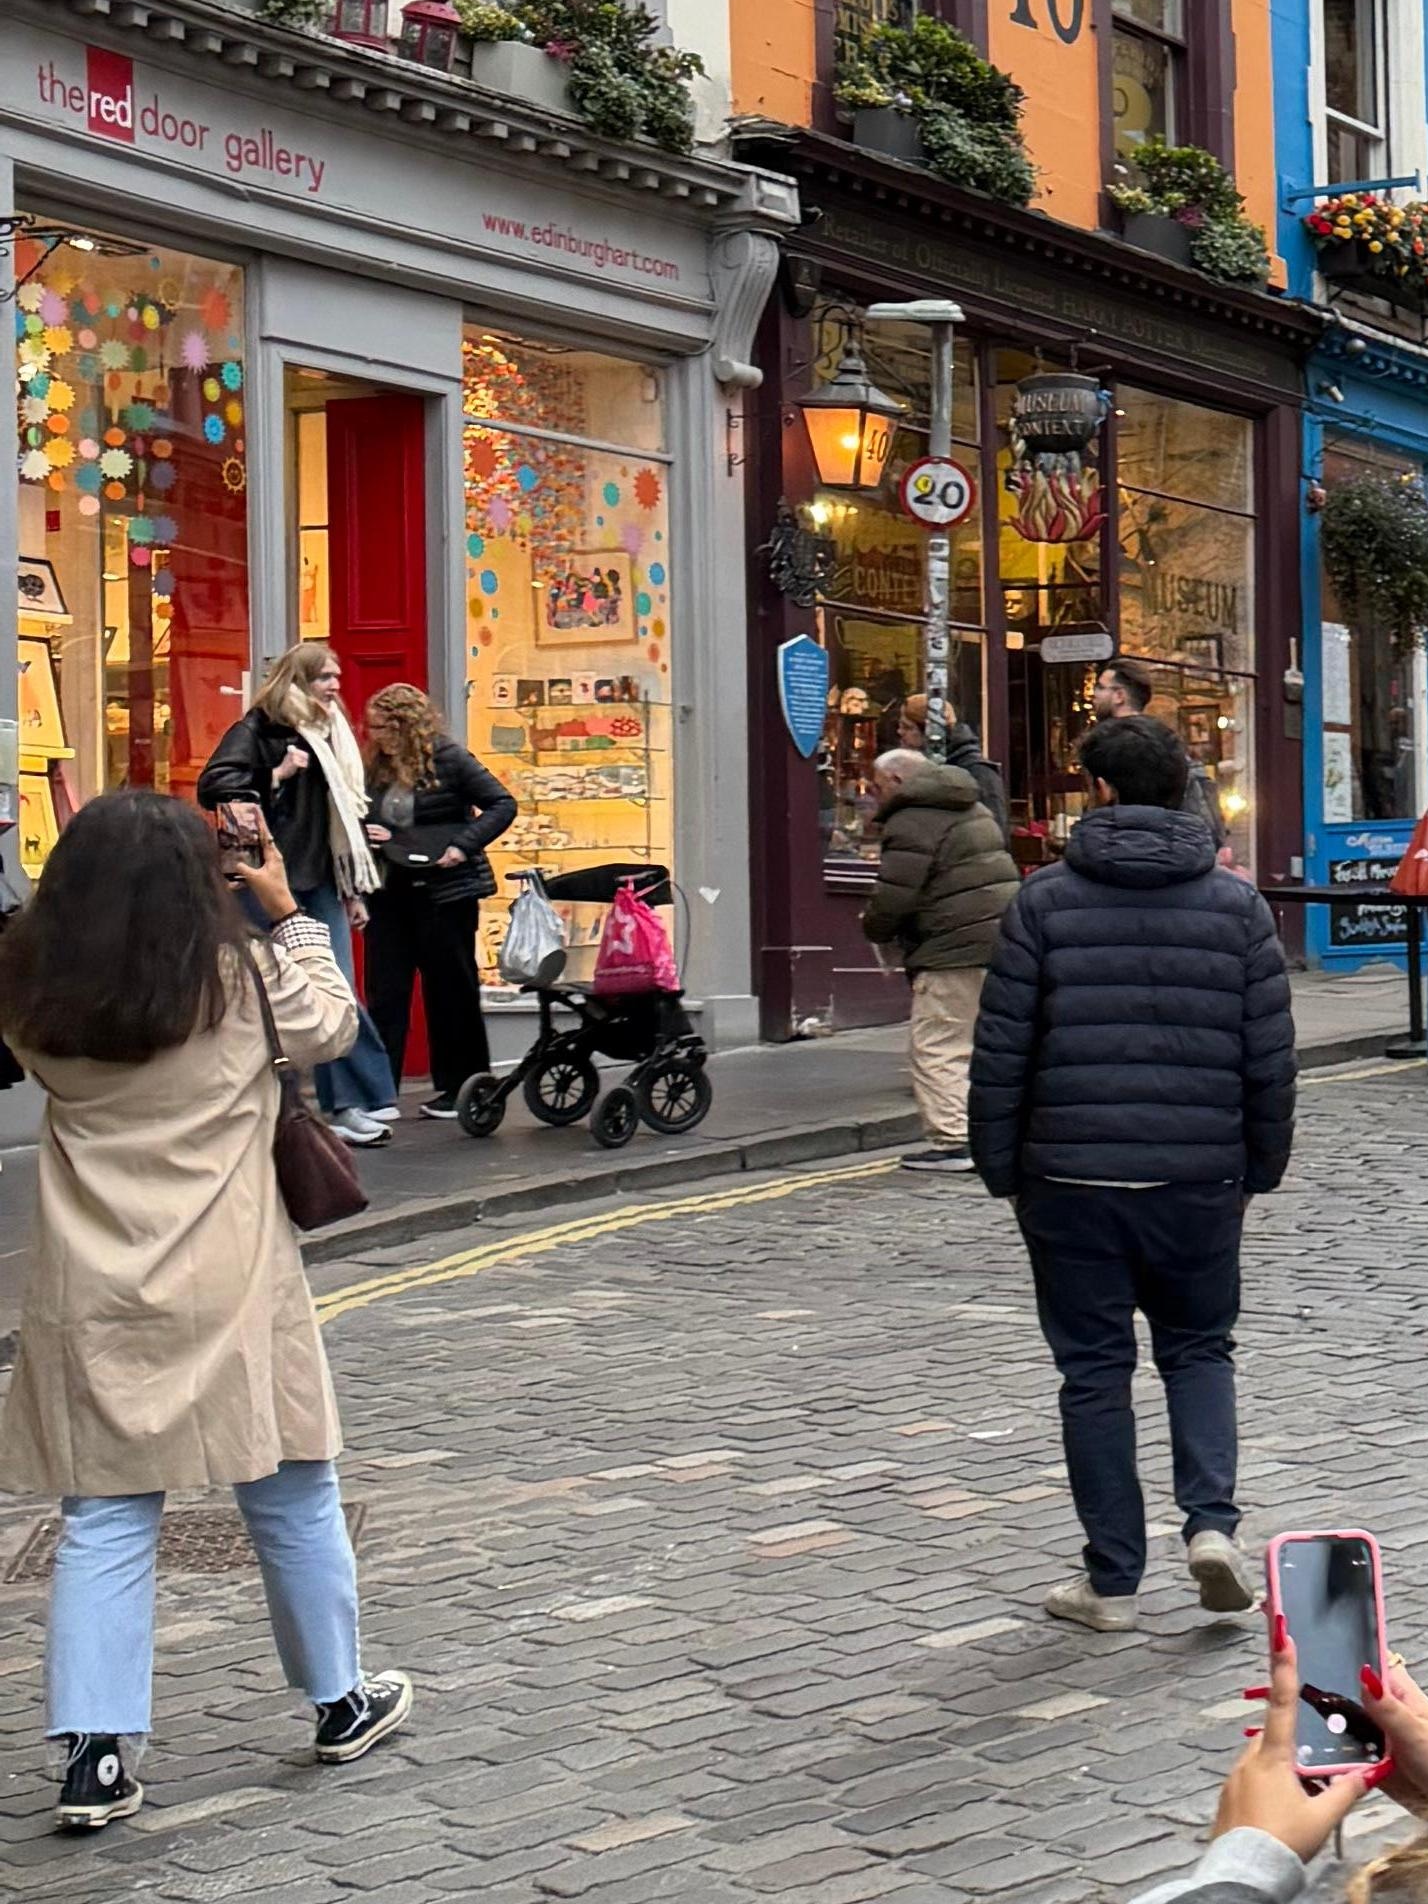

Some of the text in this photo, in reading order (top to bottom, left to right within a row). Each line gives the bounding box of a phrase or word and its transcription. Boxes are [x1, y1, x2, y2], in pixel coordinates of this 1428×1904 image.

[38, 61, 325, 192] the red door gallery
[482, 213, 680, 281] www.edinburghart.com
[866, 429, 889, 464] 40
[912, 478, 965, 510] 20
